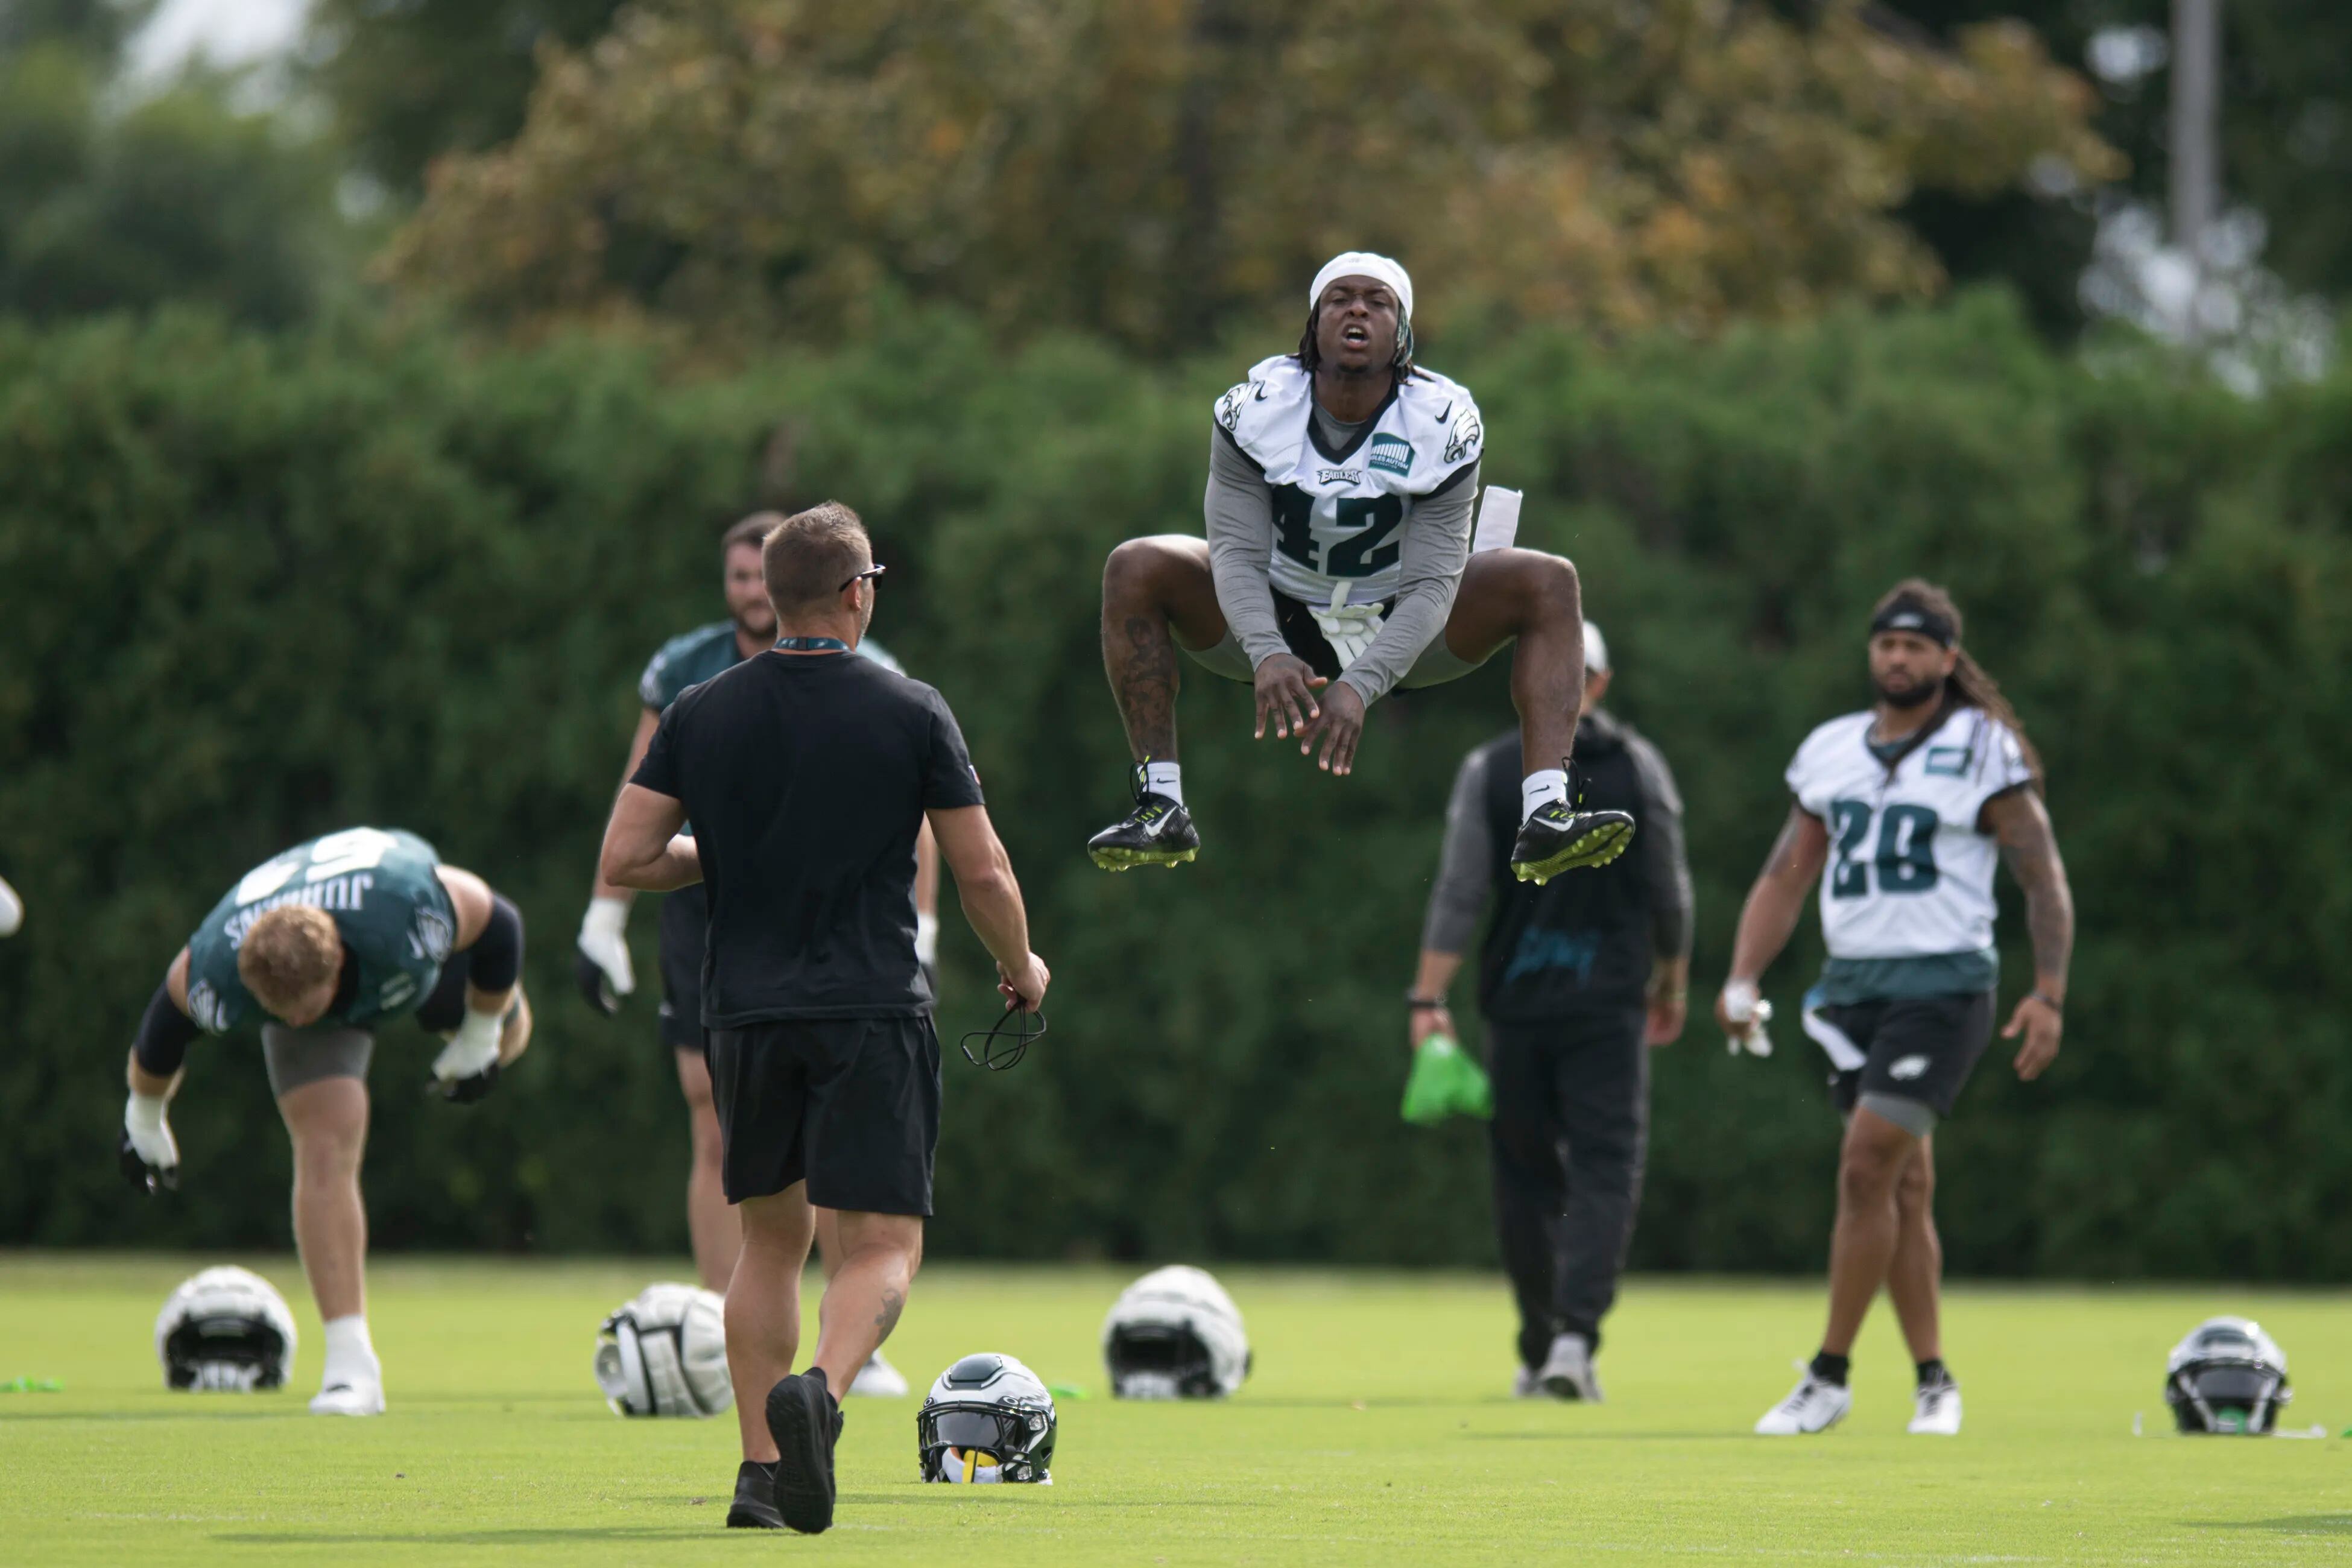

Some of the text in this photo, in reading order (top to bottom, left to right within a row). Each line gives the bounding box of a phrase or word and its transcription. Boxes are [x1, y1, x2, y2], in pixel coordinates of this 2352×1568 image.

[1385, 458, 1409, 470] AUTISM
[1319, 470, 1361, 484] EAGLES
[1272, 483, 1403, 577] 42
